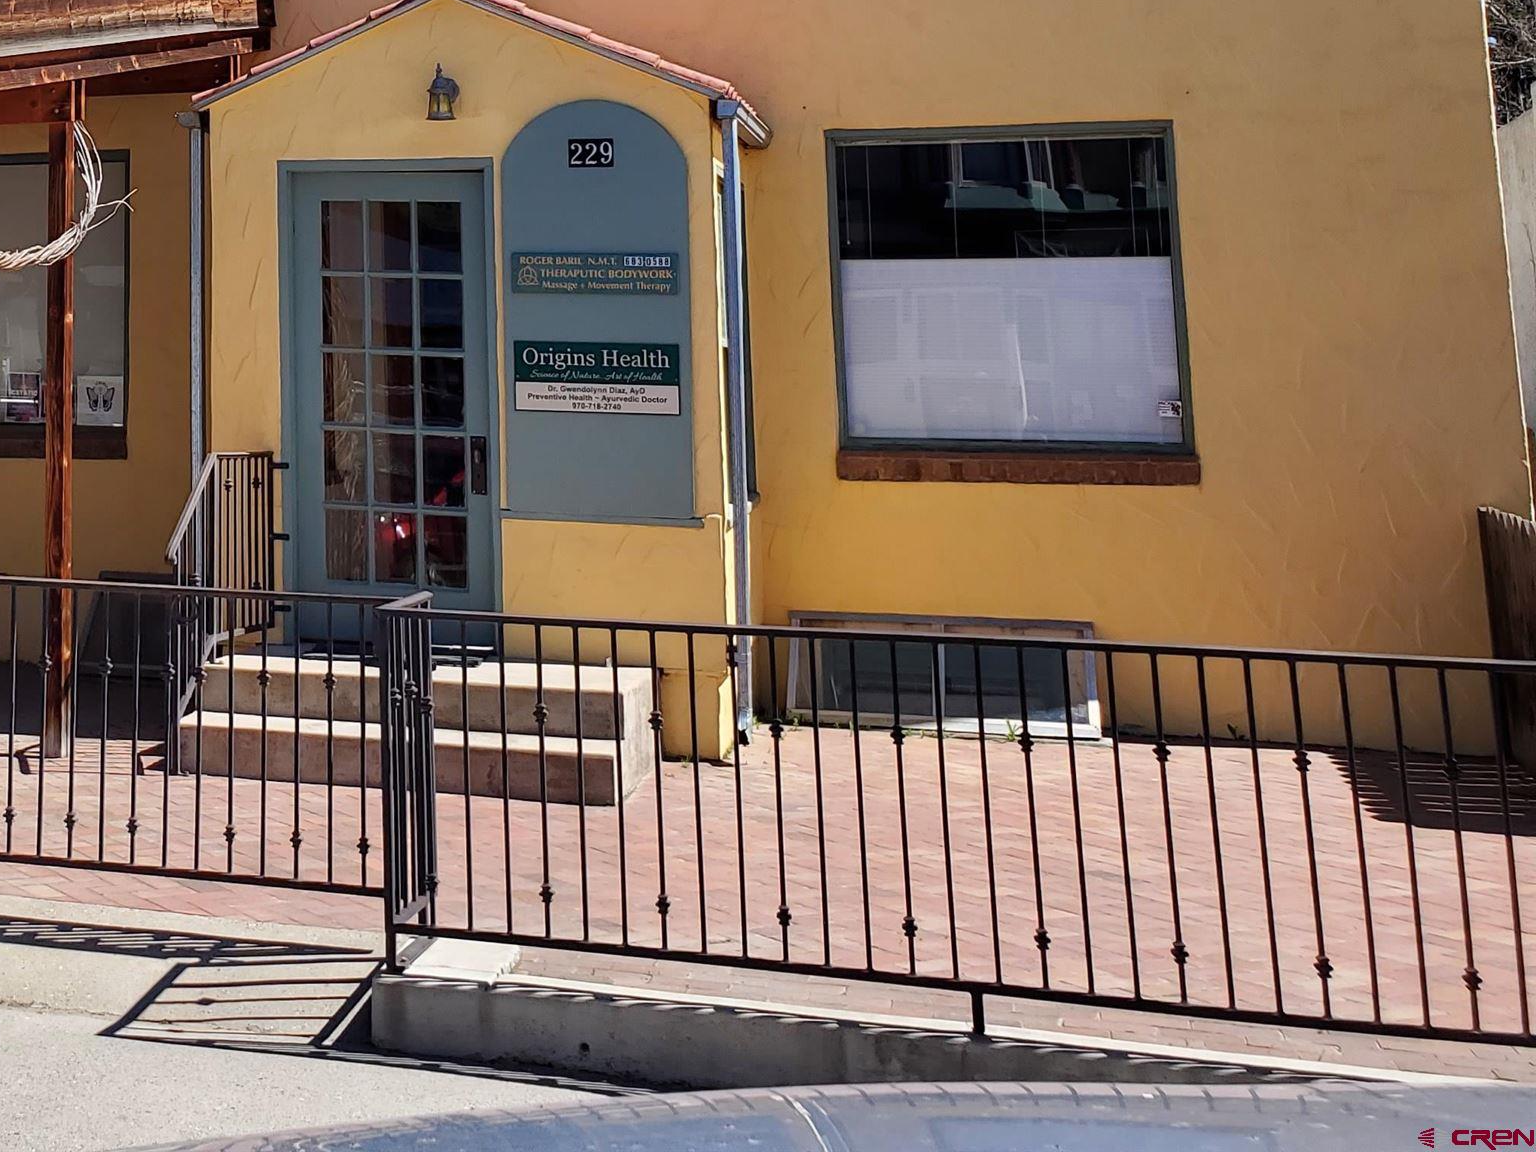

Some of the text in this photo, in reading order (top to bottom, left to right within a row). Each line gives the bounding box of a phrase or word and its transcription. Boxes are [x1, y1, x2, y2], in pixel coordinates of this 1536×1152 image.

[570, 141, 613, 165] 229
[519, 256, 555, 265] ROGER
[540, 268, 673, 279] THERAPUTIC BODYWORK
[542, 280, 578, 291] Massage
[587, 281, 633, 290] Movement
[635, 281, 671, 292] Therapy
[522, 347, 670, 370] Origins Health
[547, 384, 645, 397] Dr. Gwendolynn Diaz, AyD
[527, 392, 567, 401] Preventive
[601, 395, 640, 404] Ayurvedic
[641, 396, 668, 404] Doctor
